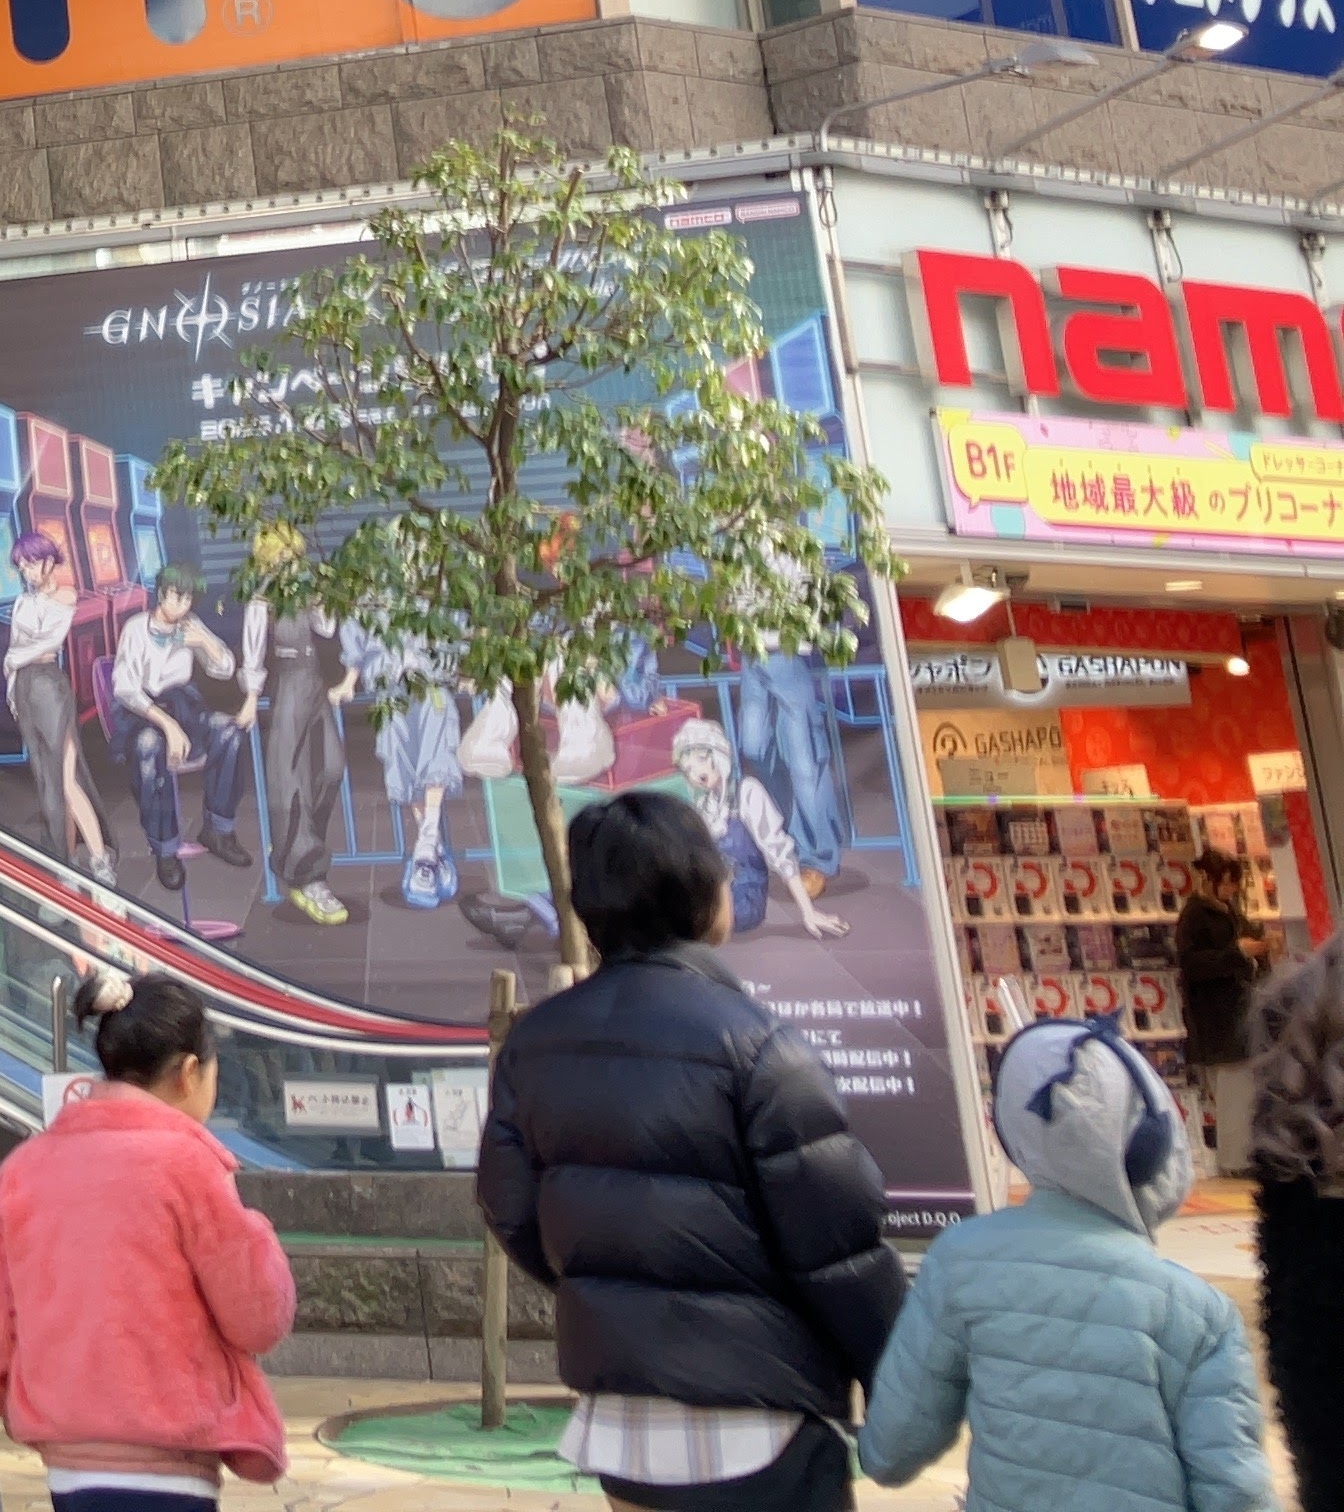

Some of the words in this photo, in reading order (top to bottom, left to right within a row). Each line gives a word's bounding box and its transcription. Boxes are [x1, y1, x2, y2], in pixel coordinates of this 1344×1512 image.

[670, 213, 724, 227] namco
[912, 249, 1344, 425] nam
[965, 439, 1016, 482] B1F
